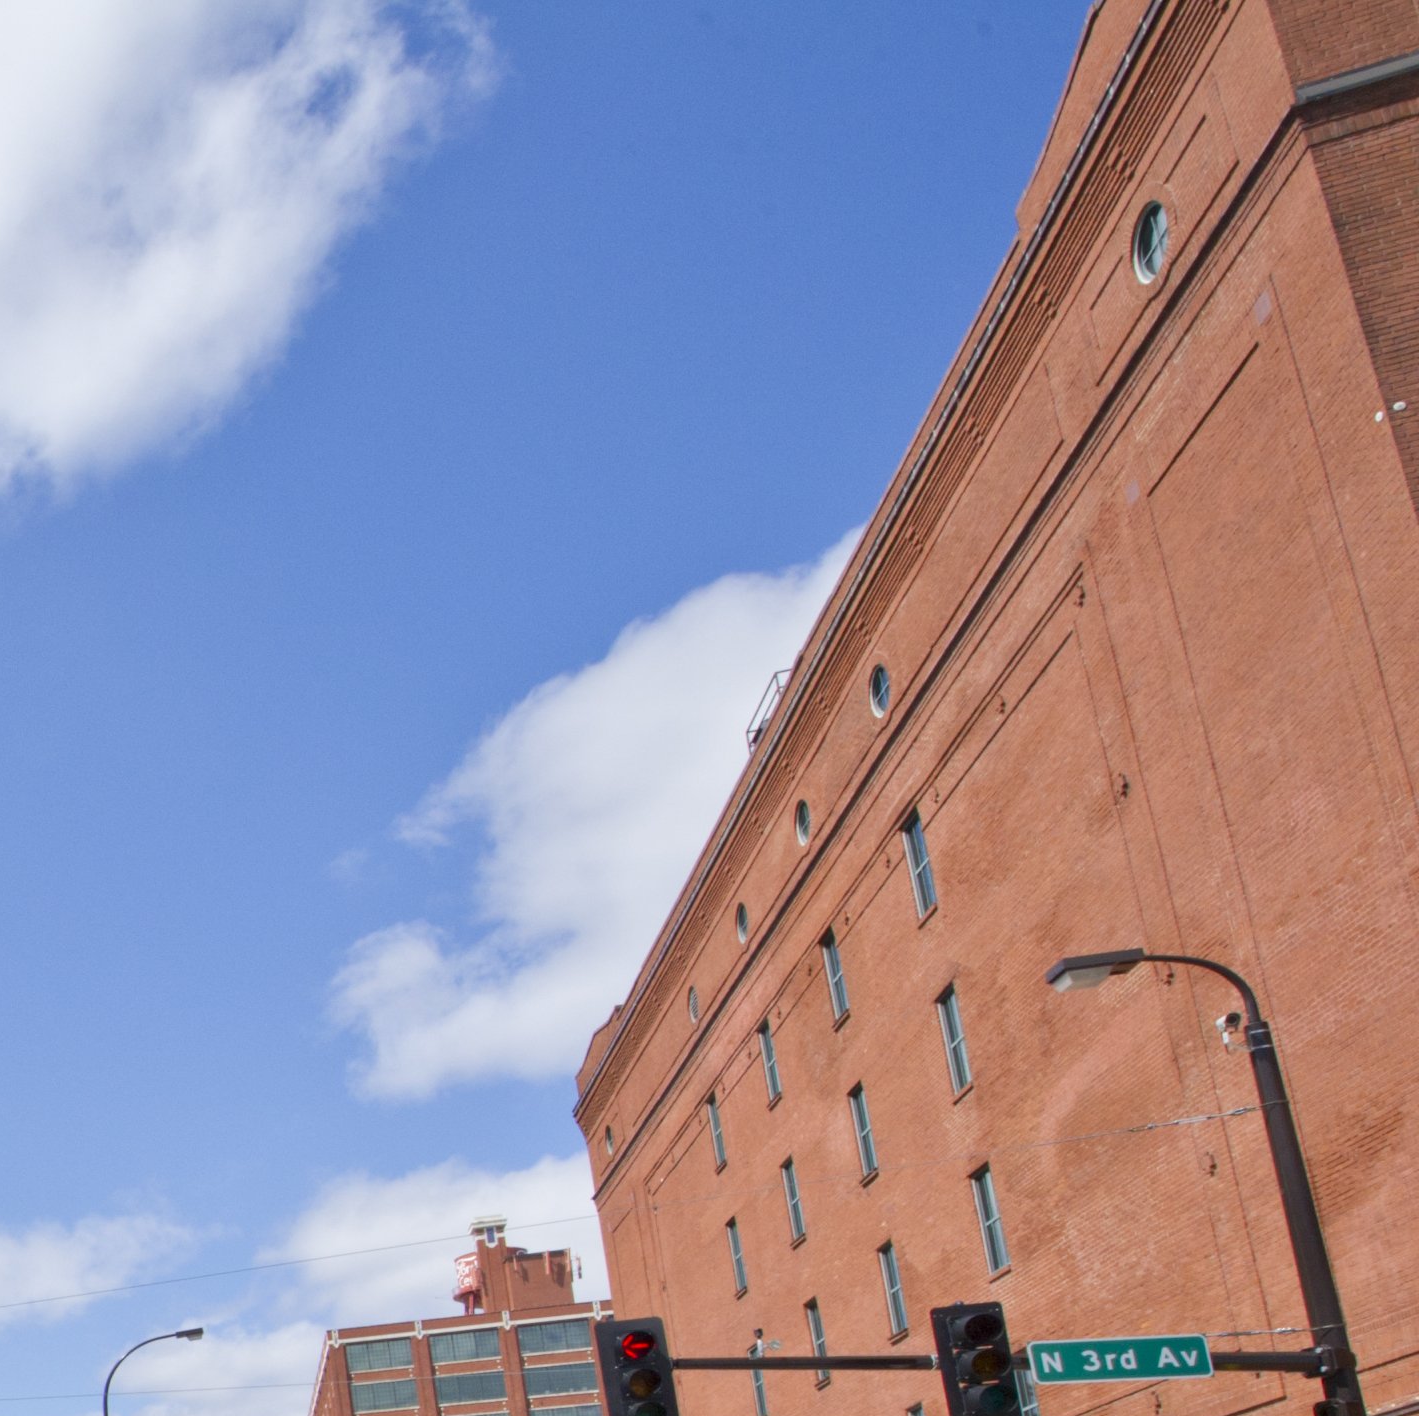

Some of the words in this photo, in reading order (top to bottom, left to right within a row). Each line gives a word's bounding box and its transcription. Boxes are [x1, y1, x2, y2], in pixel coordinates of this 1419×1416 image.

[1041, 1351, 1063, 1373] N
[1081, 1349, 1138, 1372] 3rd
[1157, 1346, 1198, 1369] Av
